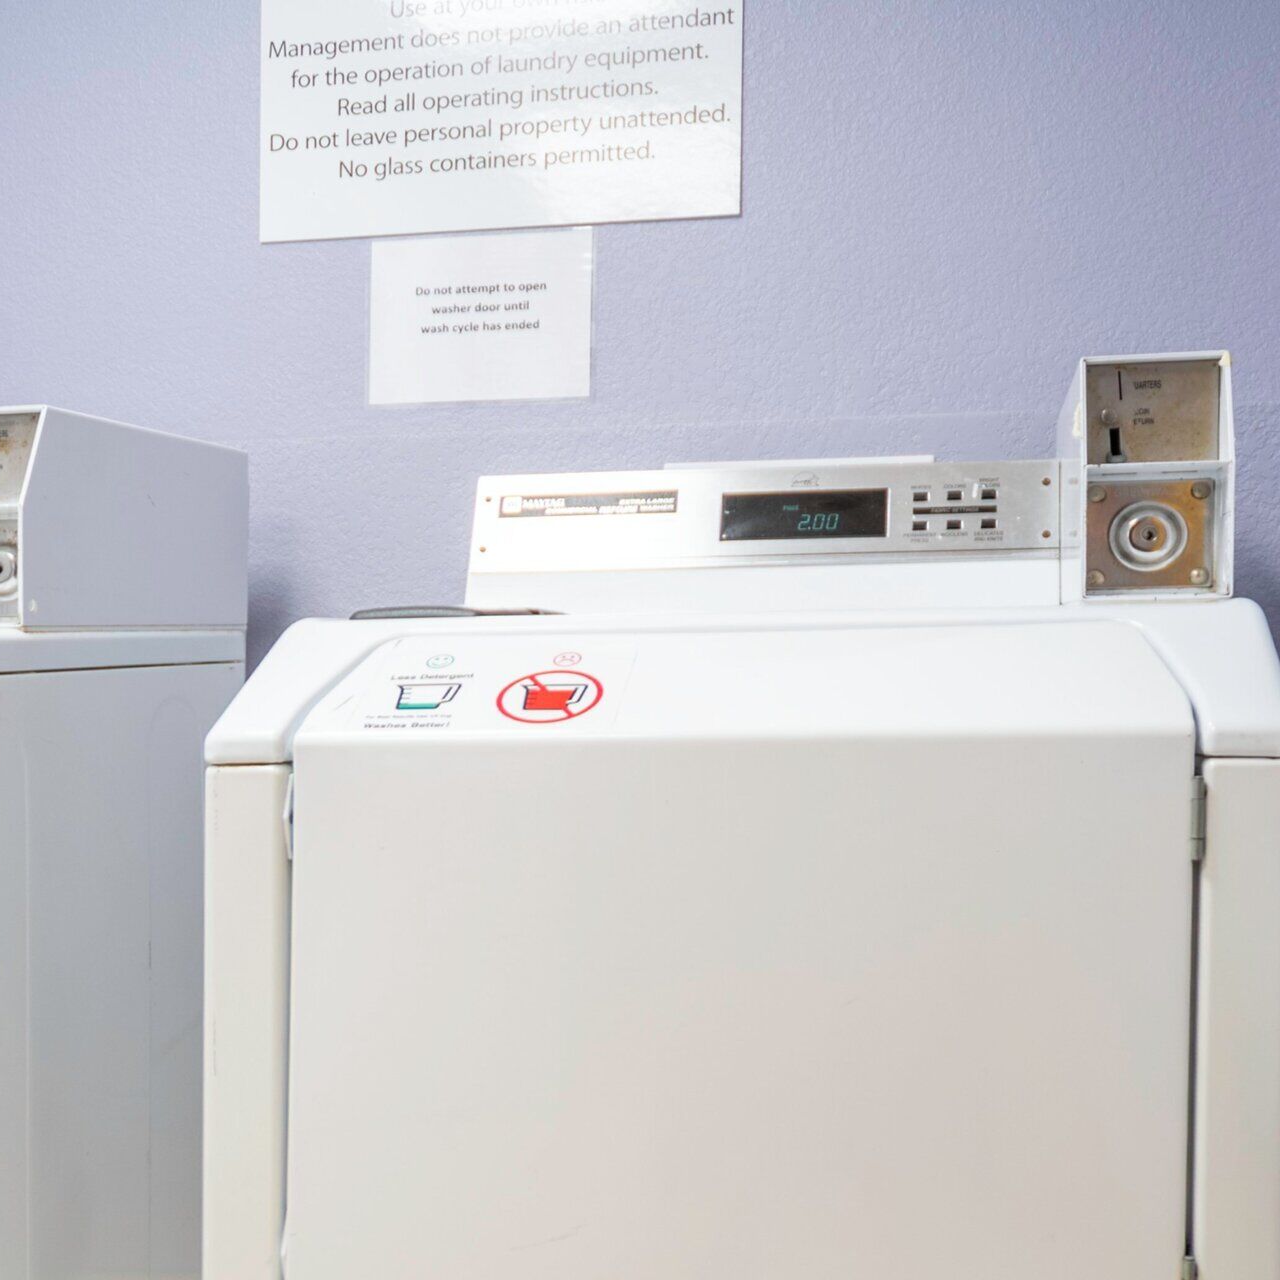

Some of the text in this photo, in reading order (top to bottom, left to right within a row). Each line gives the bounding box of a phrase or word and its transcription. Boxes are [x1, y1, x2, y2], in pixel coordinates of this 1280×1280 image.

[389, 0, 427, 18] Use
[268, 8, 735, 59] Management does not provide an attendant
[291, 42, 709, 88] for the operation of laundry equipment.
[337, 79, 659, 116] Read all operating instructions.
[269, 103, 731, 152] Do not leave personal property unattended.
[339, 140, 655, 181] No glass containers permitted.
[415, 282, 547, 297] Do not attempt to open
[432, 300, 530, 314] washer door until
[421, 320, 540, 334] wash cycle has ended
[1132, 379, 1161, 389] UARTERS
[797, 513, 839, 531] 2.00
